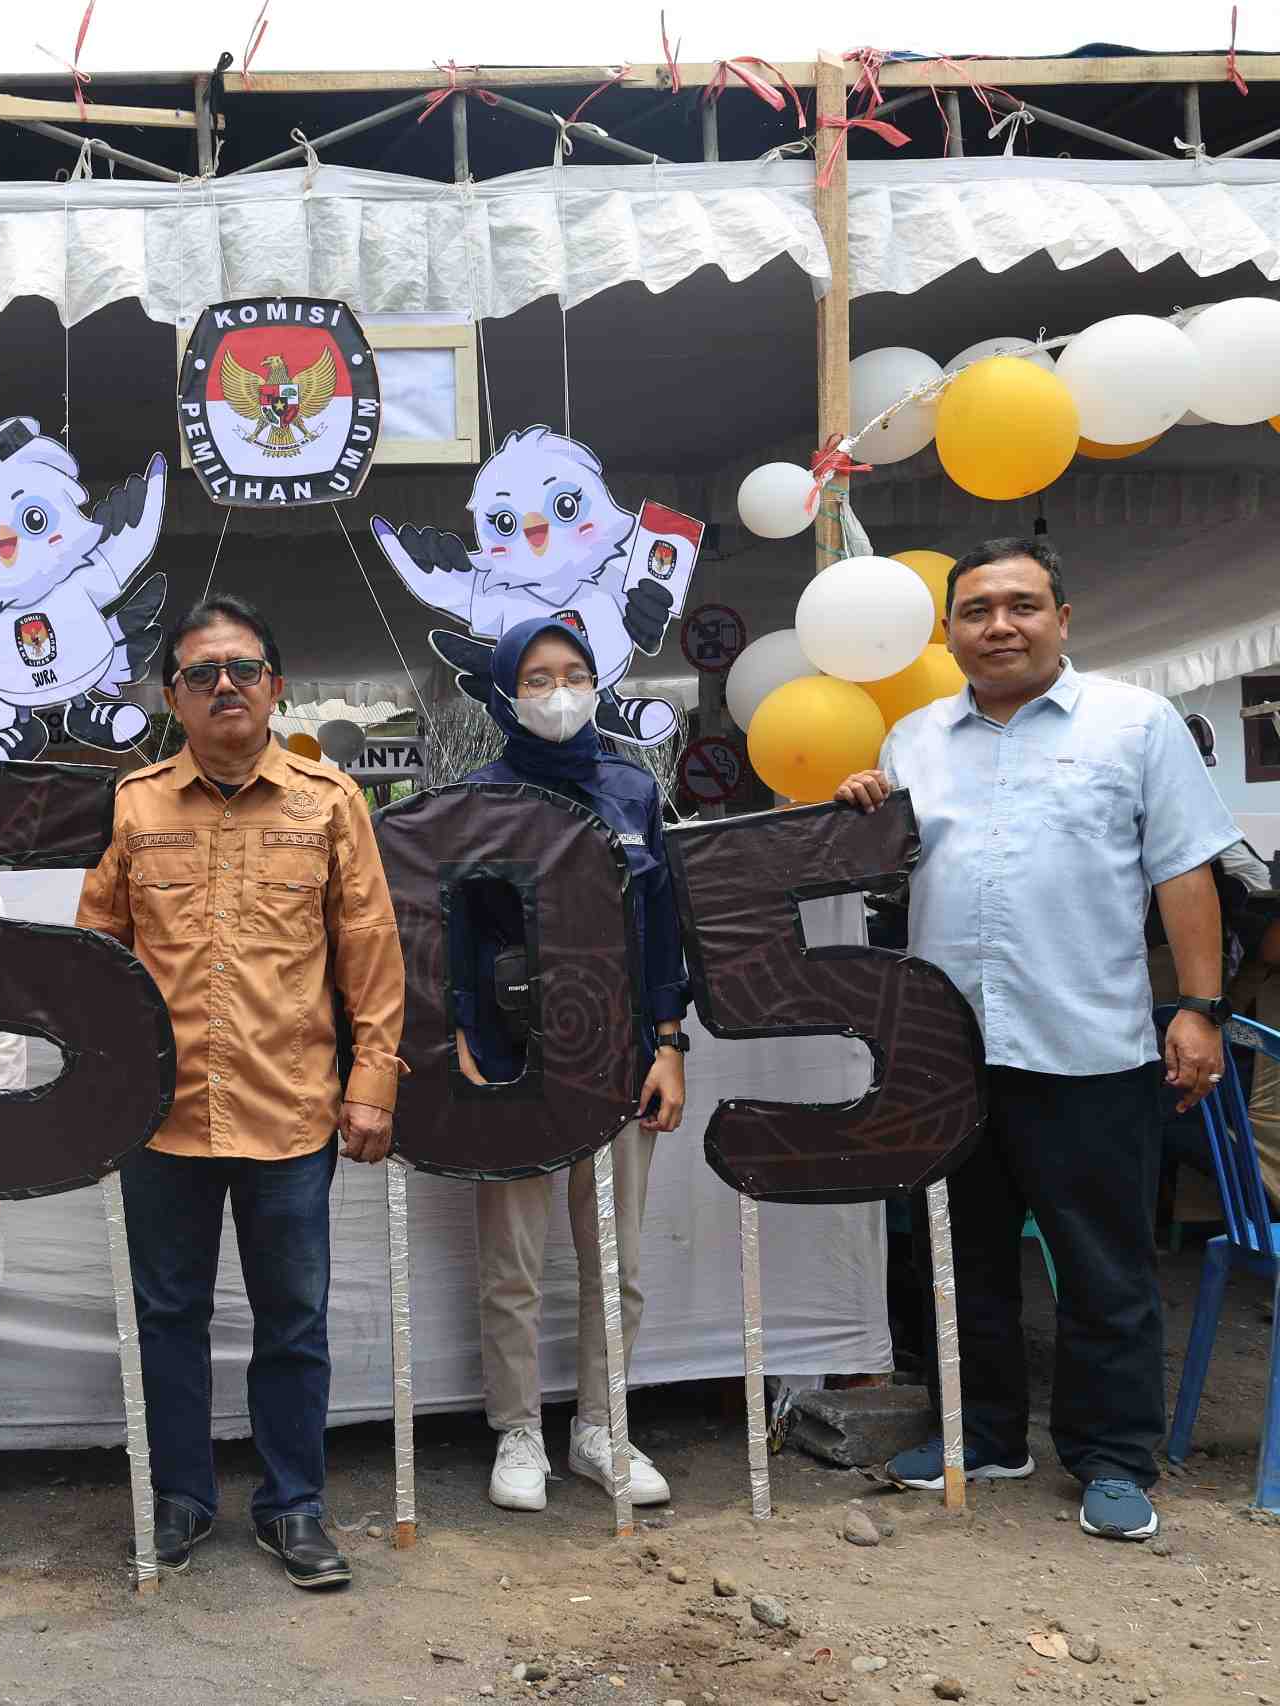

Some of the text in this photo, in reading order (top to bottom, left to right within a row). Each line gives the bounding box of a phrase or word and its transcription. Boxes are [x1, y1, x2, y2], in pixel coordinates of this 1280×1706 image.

[214, 303, 342, 328] KOMISI
[181, 402, 312, 500] PEMILIHAN
[328, 398, 378, 492] UMUM
[31, 668, 58, 688] SURA
[346, 747, 424, 768] INTA
